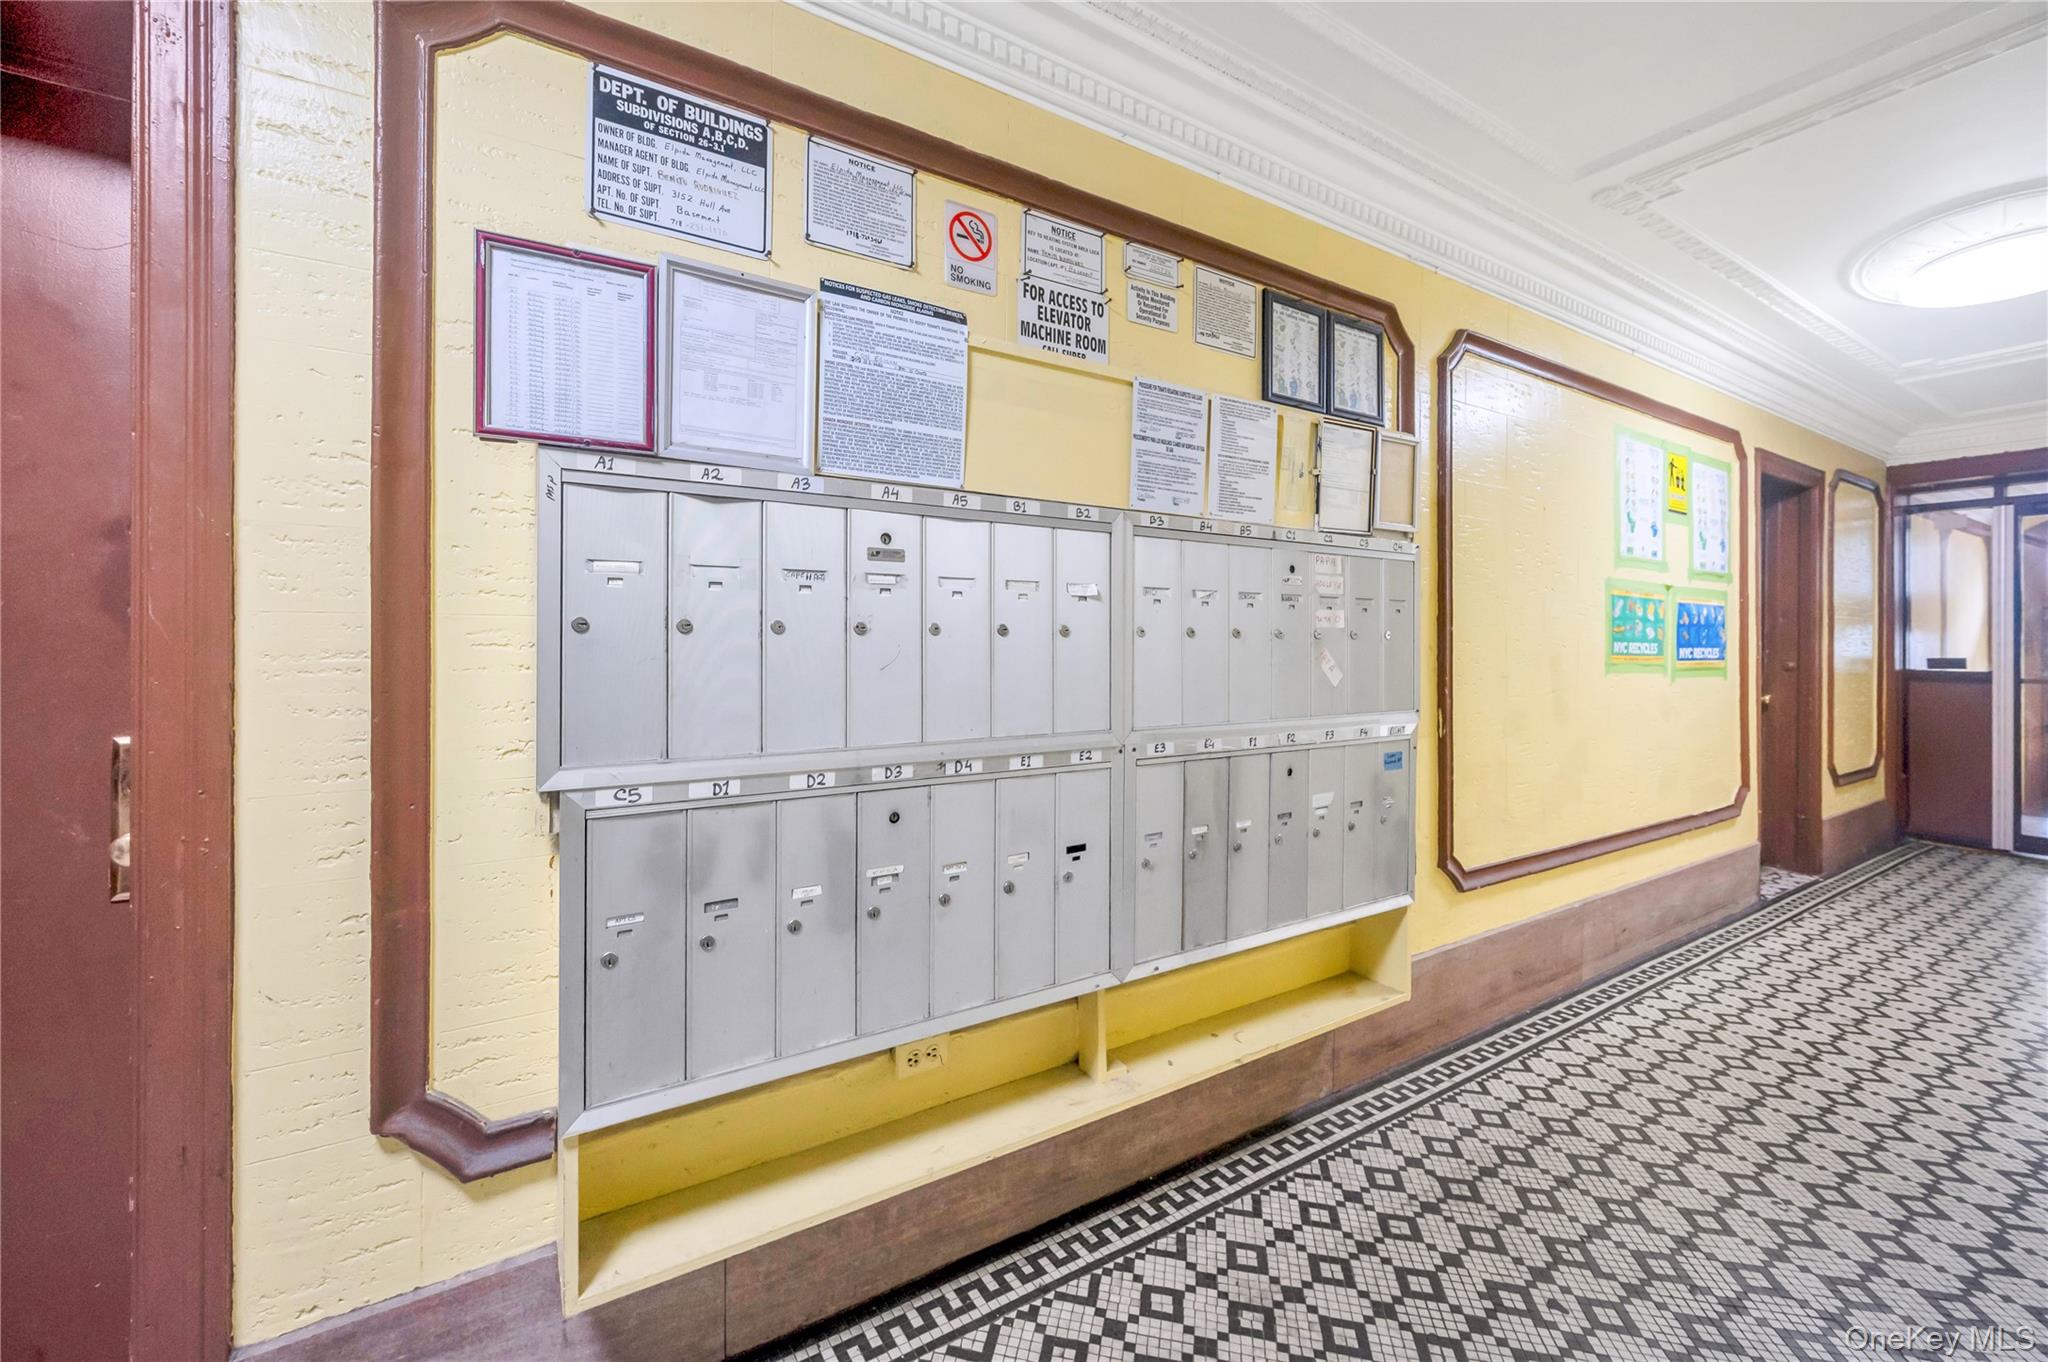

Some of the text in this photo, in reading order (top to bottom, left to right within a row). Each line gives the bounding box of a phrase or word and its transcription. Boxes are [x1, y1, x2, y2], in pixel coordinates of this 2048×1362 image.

[599, 77, 764, 141] DEPT. OF BUILDINGS
[616, 100, 749, 150] SUBDIVISIONS A,B,C,D.
[598, 123, 658, 150] OWNER OF BLDG.
[644, 121, 656, 130] OF
[659, 126, 695, 143] SECTION
[598, 139, 690, 173] MANAGER AGENT OF BLDG.
[598, 153, 653, 178] NAME OF SUPT.
[848, 158, 876, 172] NOTICE
[597, 169, 664, 195] ADDRESS OF SUPT.
[597, 184, 661, 209] APT. No. OF SUPT.
[671, 189, 693, 203] 3152
[597, 197, 660, 222] TEL. No. OF SUPT.
[676, 205, 721, 224] Basement
[1051, 225, 1076, 240] NOTICE
[1055, 247, 1073, 257] LOCATED
[950, 264, 964, 274] NO
[950, 272, 991, 290] SMOKING
[824, 280, 845, 290] NOTICES
[855, 288, 882, 298] SUSPECTED
[871, 297, 890, 306] CARBON
[891, 301, 916, 312] MONOXIDE
[1022, 282, 1105, 318] FOR ACCESS TO
[1037, 305, 1092, 333] ELEVATOR
[1020, 319, 1106, 355] MACHINE ROOM
[594, 455, 614, 471] A1
[701, 468, 724, 481] A2
[790, 477, 811, 490] A3
[881, 486, 899, 501] A4
[951, 494, 968, 507] A5
[1012, 501, 1027, 513] B1
[1075, 507, 1092, 519] B2
[1150, 515, 1165, 526] B3
[1200, 521, 1212, 532] B4
[1240, 525, 1252, 536] B5
[1286, 530, 1296, 540] C1
[1324, 534, 1333, 543] C2
[1360, 538, 1369, 548] C3
[1393, 542, 1403, 551] C4
[1613, 642, 1658, 654] NYC RECYCLES
[1679, 648, 1720, 659] NYC RECYCLES
[1287, 733, 1297, 743] F2
[1325, 730, 1335, 740] F3
[1359, 728, 1369, 737] F4
[1154, 742, 1167, 753] E3
[1204, 738, 1215, 750] E4
[1249, 737, 1258, 748] F1
[1020, 755, 1031, 767] E1
[1078, 751, 1093, 762] E2
[884, 765, 903, 779] D3
[955, 760, 972, 773] D4
[806, 773, 827, 789] D2
[712, 780, 730, 796] D1
[613, 787, 642, 804] C5
